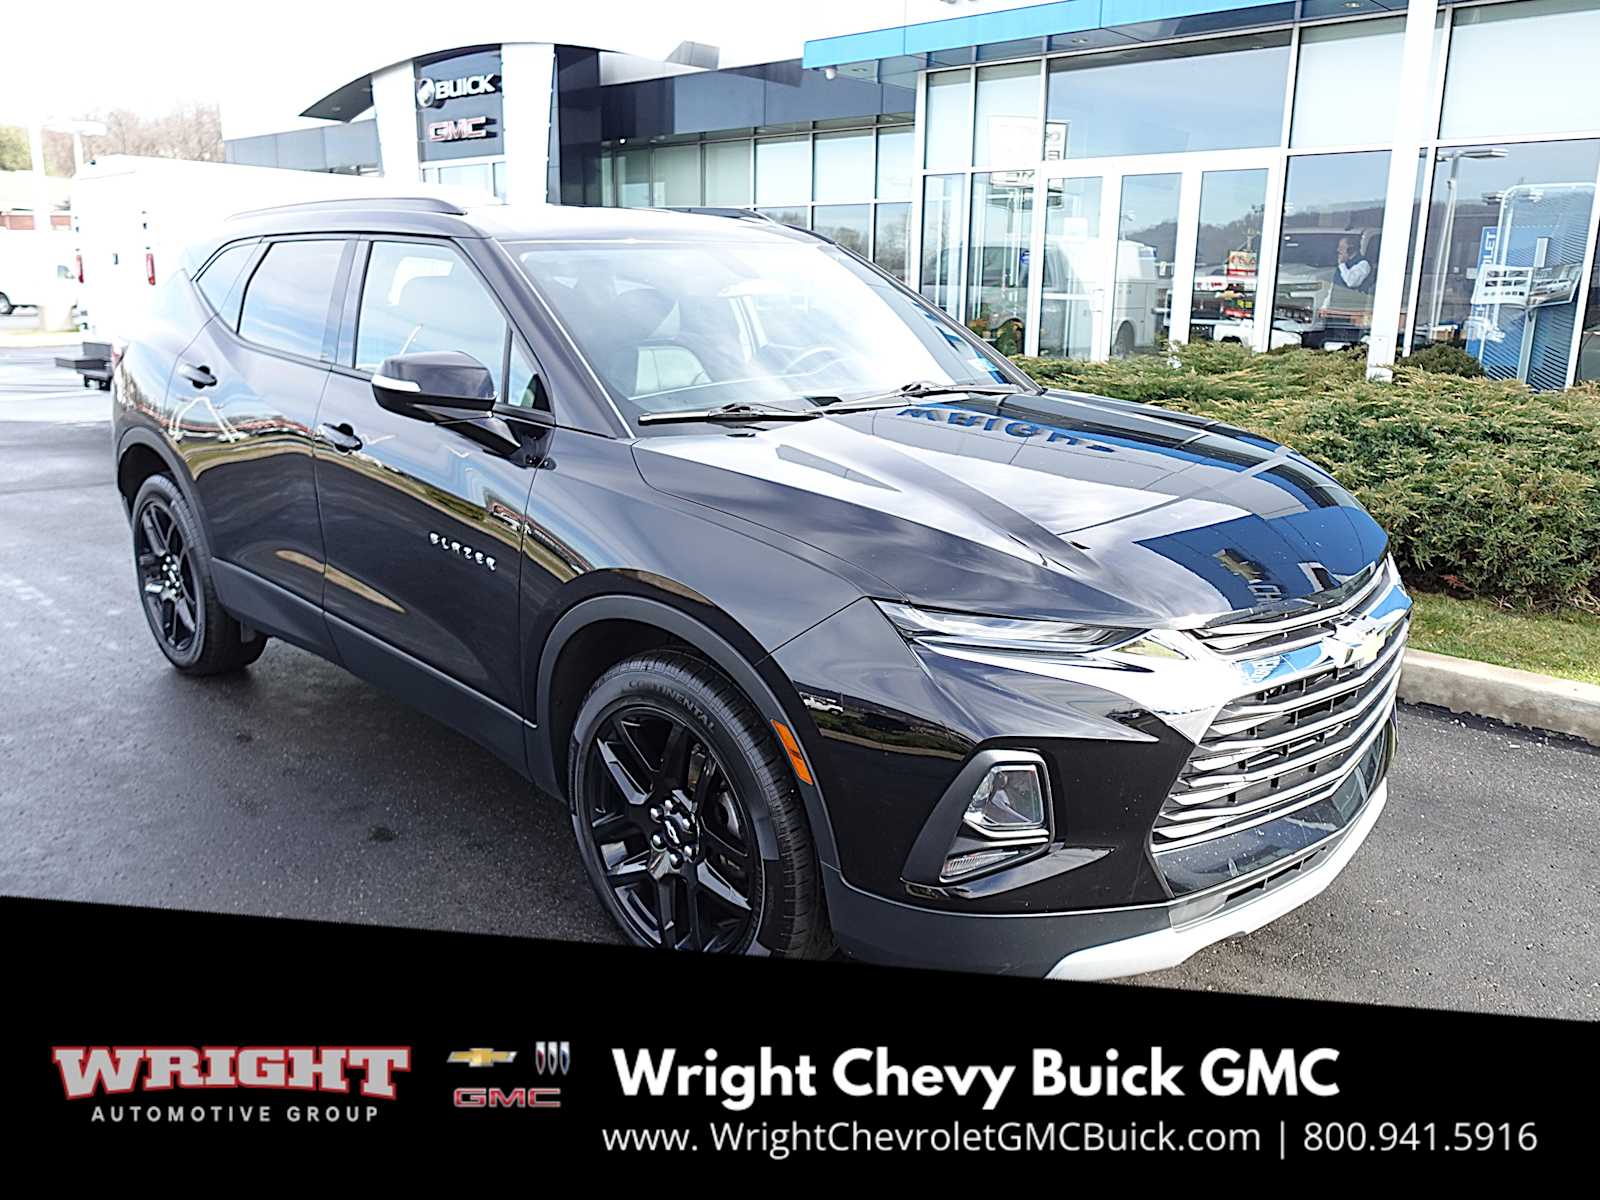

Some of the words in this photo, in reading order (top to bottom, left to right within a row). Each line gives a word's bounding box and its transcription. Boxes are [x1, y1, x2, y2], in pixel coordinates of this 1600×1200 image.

[435, 74, 496, 99] BUICK
[429, 116, 487, 141] GMC
[429, 532, 496, 572] BLAZER
